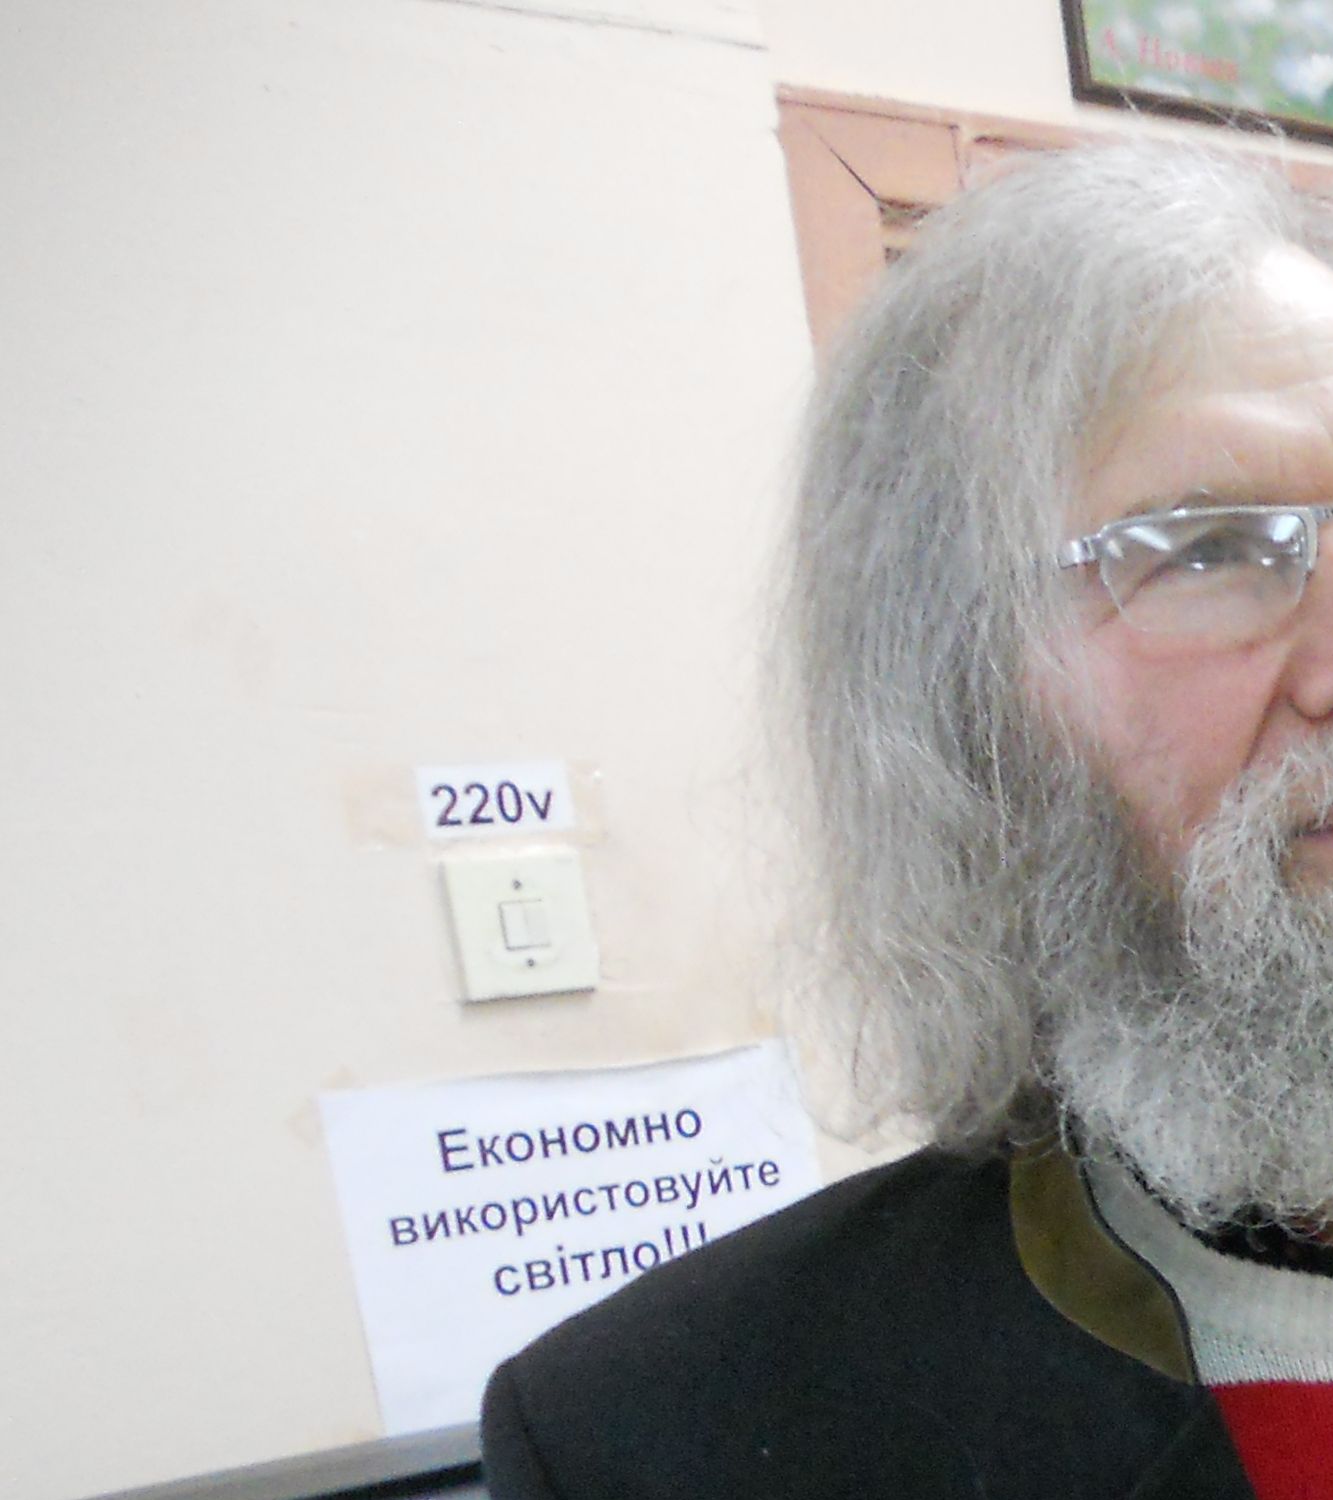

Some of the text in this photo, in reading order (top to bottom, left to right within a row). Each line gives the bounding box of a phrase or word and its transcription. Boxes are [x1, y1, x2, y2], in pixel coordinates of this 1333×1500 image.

[430, 781, 555, 827] 220v
[437, 1106, 703, 1172] Економно
[388, 1155, 782, 1248] використовуйте
